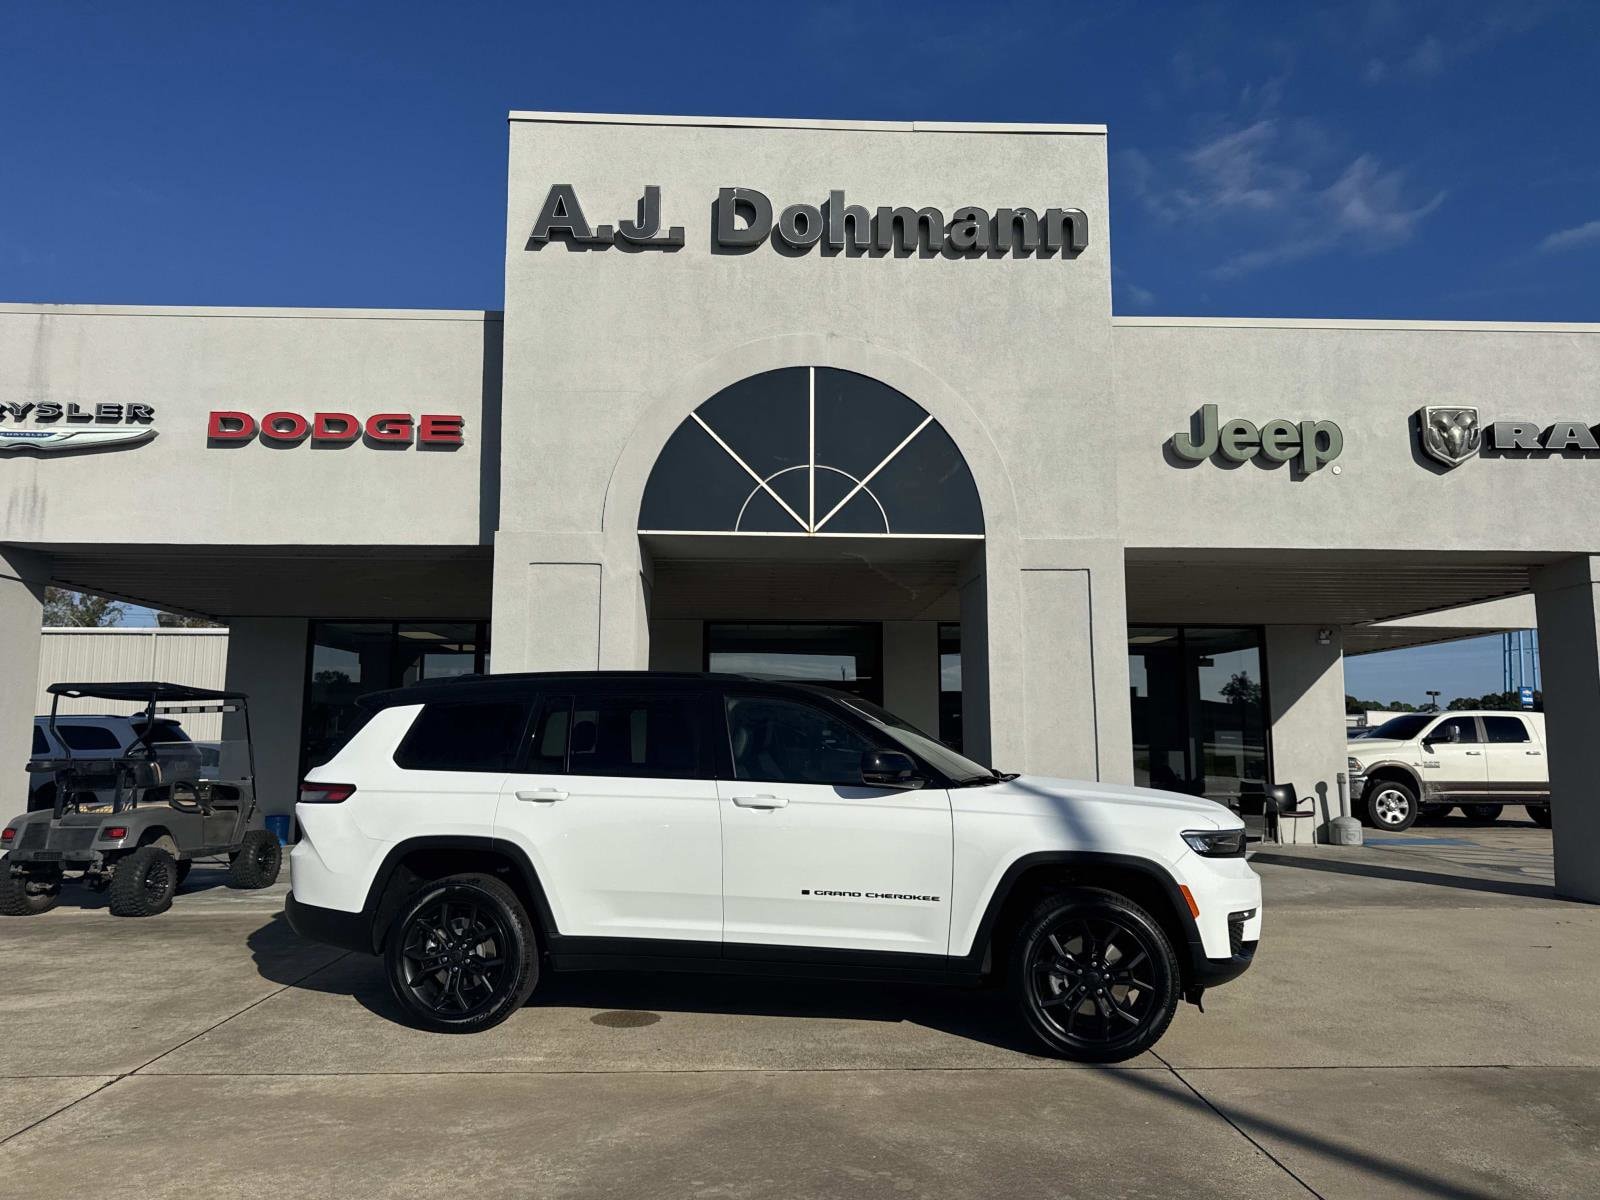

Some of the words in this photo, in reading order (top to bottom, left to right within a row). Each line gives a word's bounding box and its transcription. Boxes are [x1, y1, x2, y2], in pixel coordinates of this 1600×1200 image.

[527, 184, 685, 246] A.J.
[715, 187, 1090, 250] Dohmann
[0, 402, 154, 419] YSLER
[207, 411, 464, 445] DODGE
[1172, 404, 1343, 474] Jeep
[1493, 422, 1600, 449] RA
[813, 890, 861, 898] GRAND
[865, 892, 940, 901] CHEROKEE
